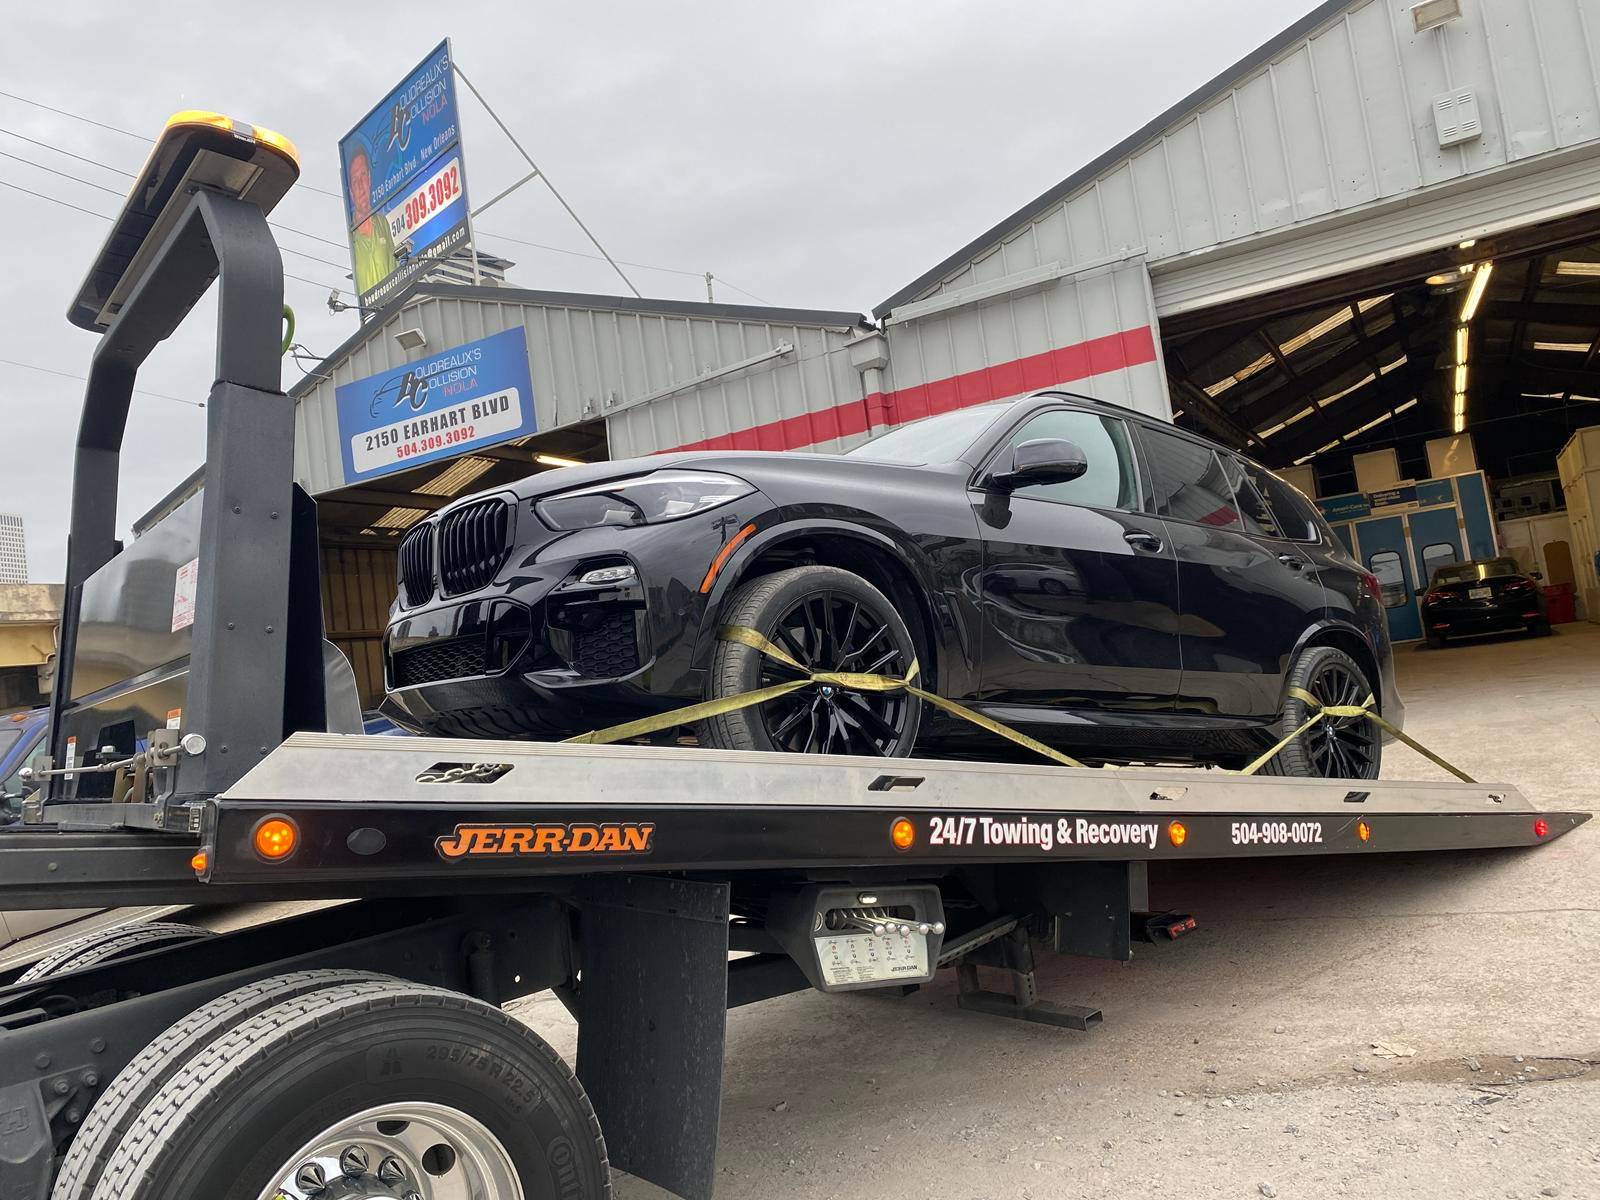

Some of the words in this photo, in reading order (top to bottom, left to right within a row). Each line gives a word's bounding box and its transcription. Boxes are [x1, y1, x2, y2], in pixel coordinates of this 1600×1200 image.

[422, 94, 448, 125] NOLA
[372, 184, 385, 203] 2150
[385, 168, 404, 192] Earhart
[421, 145, 433, 161] New
[433, 124, 456, 150] Orleans
[391, 214, 406, 237] 504
[405, 165, 459, 230] 309.3092
[443, 377, 479, 397] NOLA
[365, 428, 399, 452] 2150
[403, 407, 467, 440] EARHART
[472, 395, 510, 420] BLVD
[396, 425, 476, 458] 504.309.3092
[439, 826, 654, 857] JERR-DAN
[929, 817, 977, 845] 24/7
[979, 817, 1053, 851] Towing
[1056, 818, 1074, 844] &
[1075, 818, 1159, 850] Recovery
[1231, 822, 1323, 845] 504-908-0072
